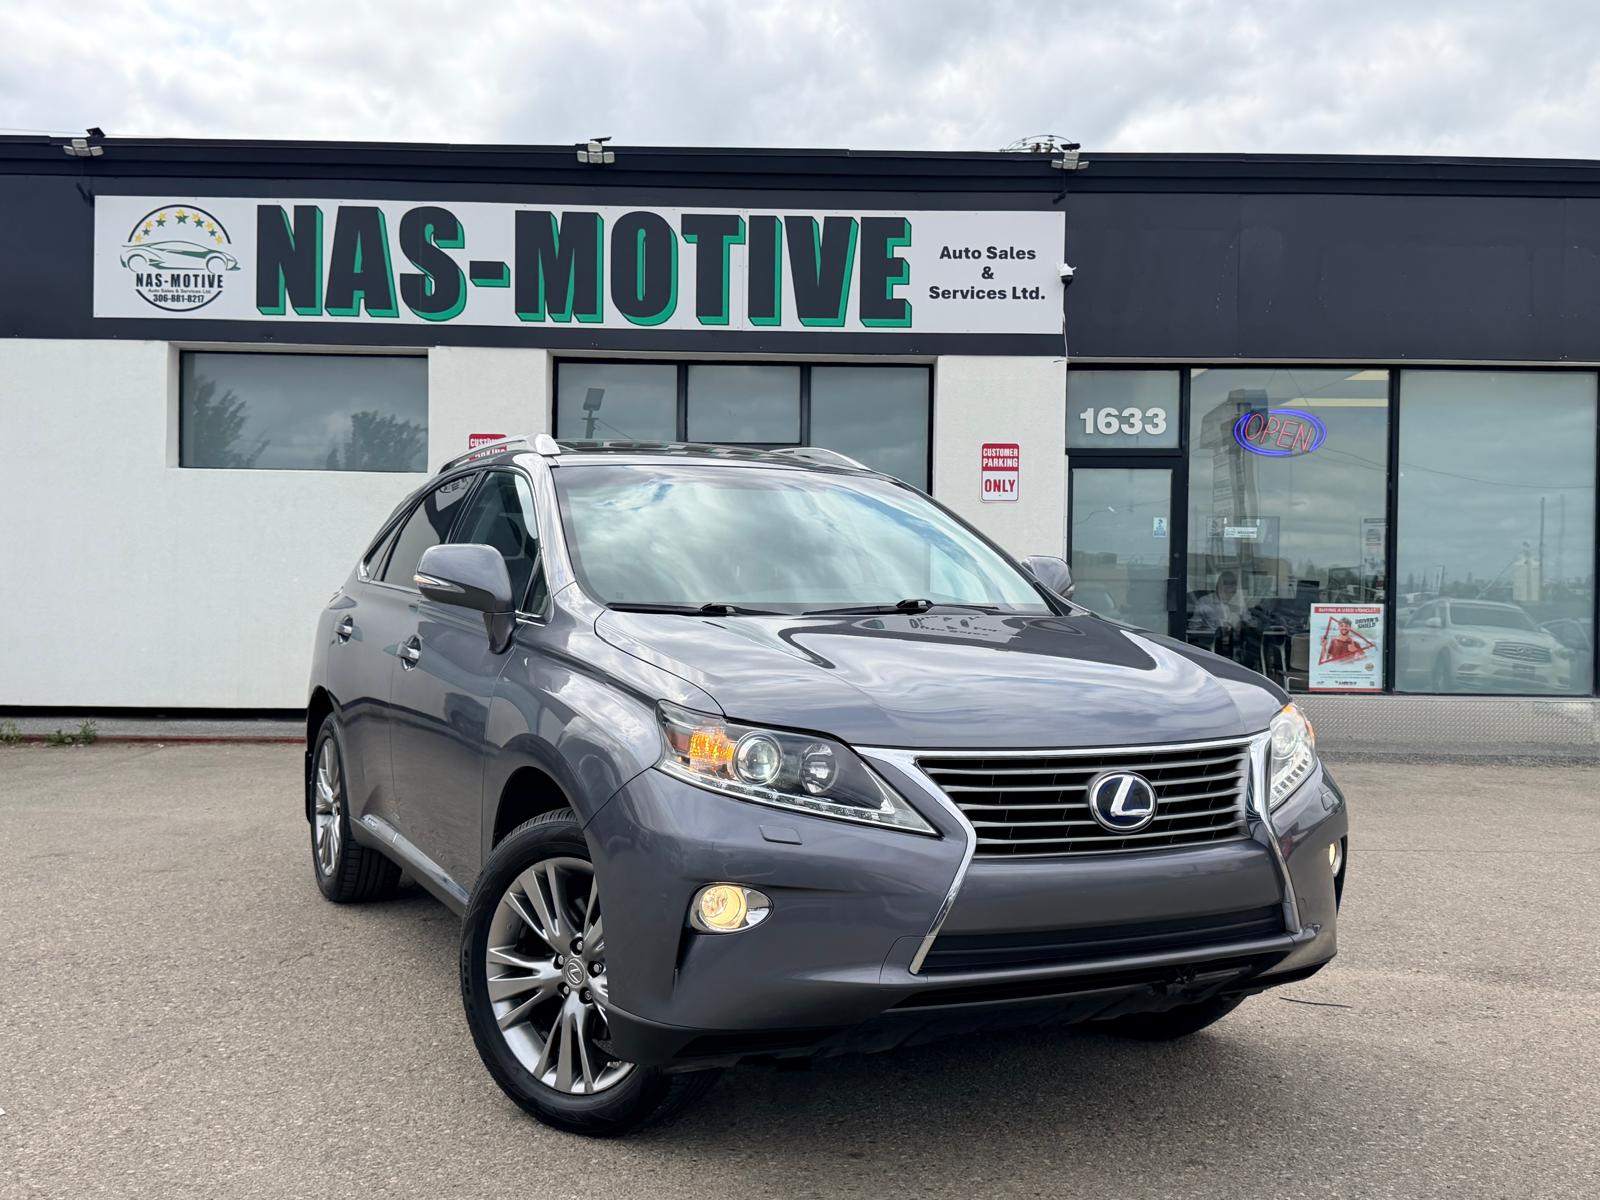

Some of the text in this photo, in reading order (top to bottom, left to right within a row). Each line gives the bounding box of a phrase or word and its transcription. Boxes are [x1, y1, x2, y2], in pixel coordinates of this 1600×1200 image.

[939, 246, 1036, 260] Auto Sales
[256, 204, 912, 328] NAS-MOTIVE
[981, 266, 994, 280] &
[136, 273, 223, 288] NAS-MOTIVE
[153, 294, 205, 303] 306-881-8217
[929, 286, 1046, 300] Services Ltd.
[1079, 407, 1167, 435] 1633
[1244, 413, 1313, 452] OPEN
[982, 447, 1018, 457] CUSTOMER
[982, 457, 1018, 468] PARKING
[984, 478, 1016, 493] ONLY
